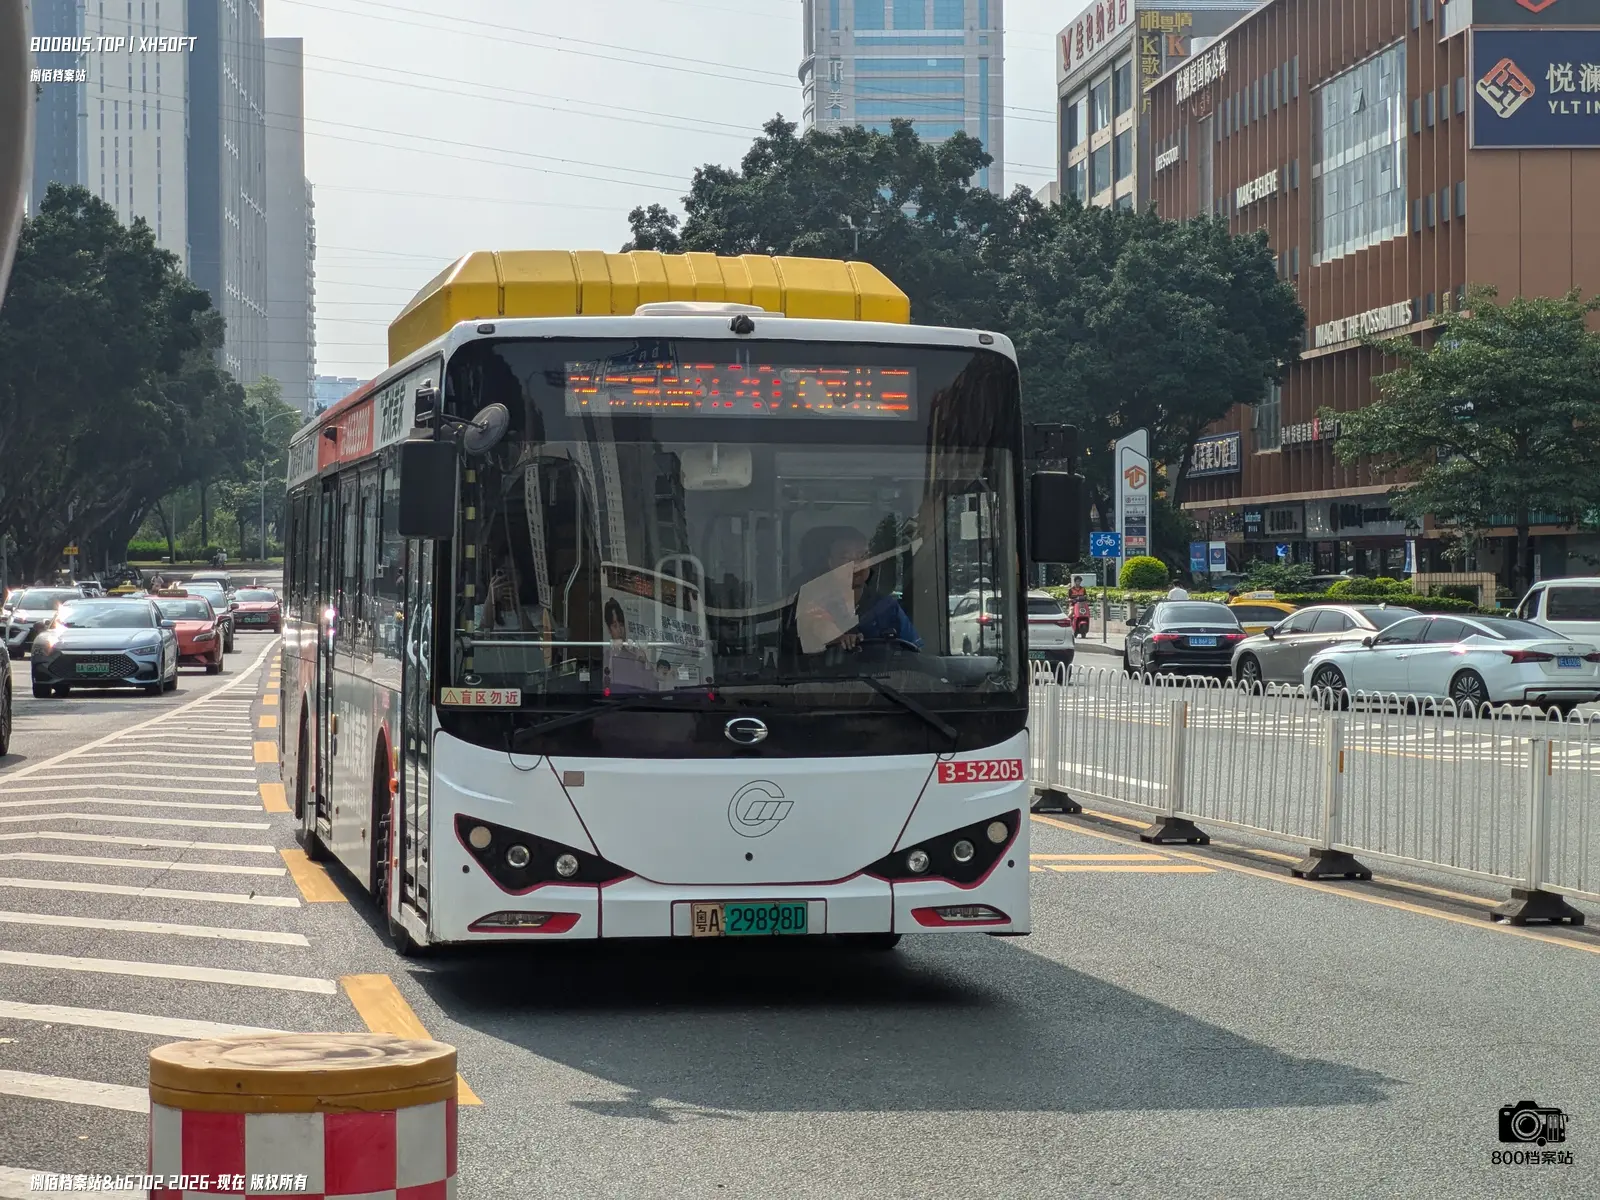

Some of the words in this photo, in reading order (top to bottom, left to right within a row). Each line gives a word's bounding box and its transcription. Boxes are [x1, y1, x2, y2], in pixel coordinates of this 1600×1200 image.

[1315, 318, 1346, 348] IMAGINE
[1346, 313, 1360, 340] THE
[1360, 299, 1412, 336] POSSIBILITIES
[460, 690, 518, 706] 盲区勿近
[945, 760, 1020, 782] 3-52205
